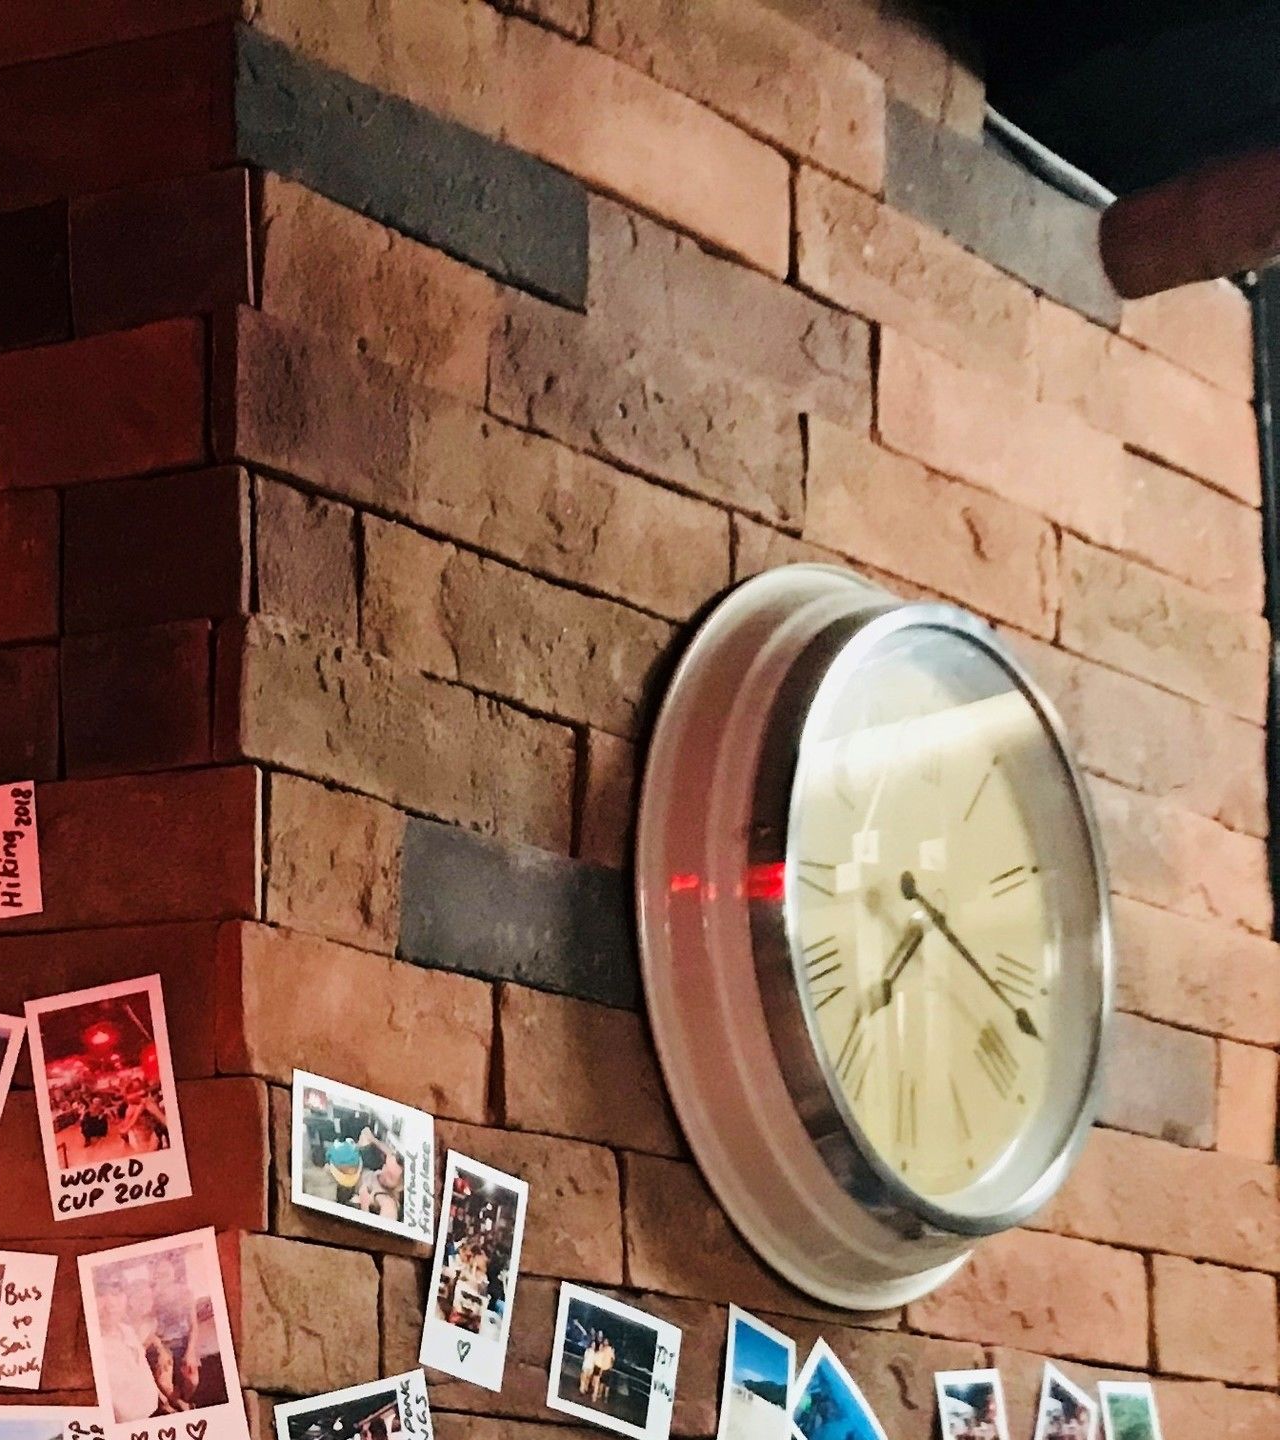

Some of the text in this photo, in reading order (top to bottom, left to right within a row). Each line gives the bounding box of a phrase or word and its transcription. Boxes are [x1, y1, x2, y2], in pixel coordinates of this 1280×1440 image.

[13, 787, 35, 827] 2018
[0, 831, 22, 909] Hiking
[58, 1160, 145, 1186] WORLD
[56, 1172, 171, 1211] CUP 2018
[3, 1282, 42, 1306] Bus
[12, 1313, 33, 1330] to
